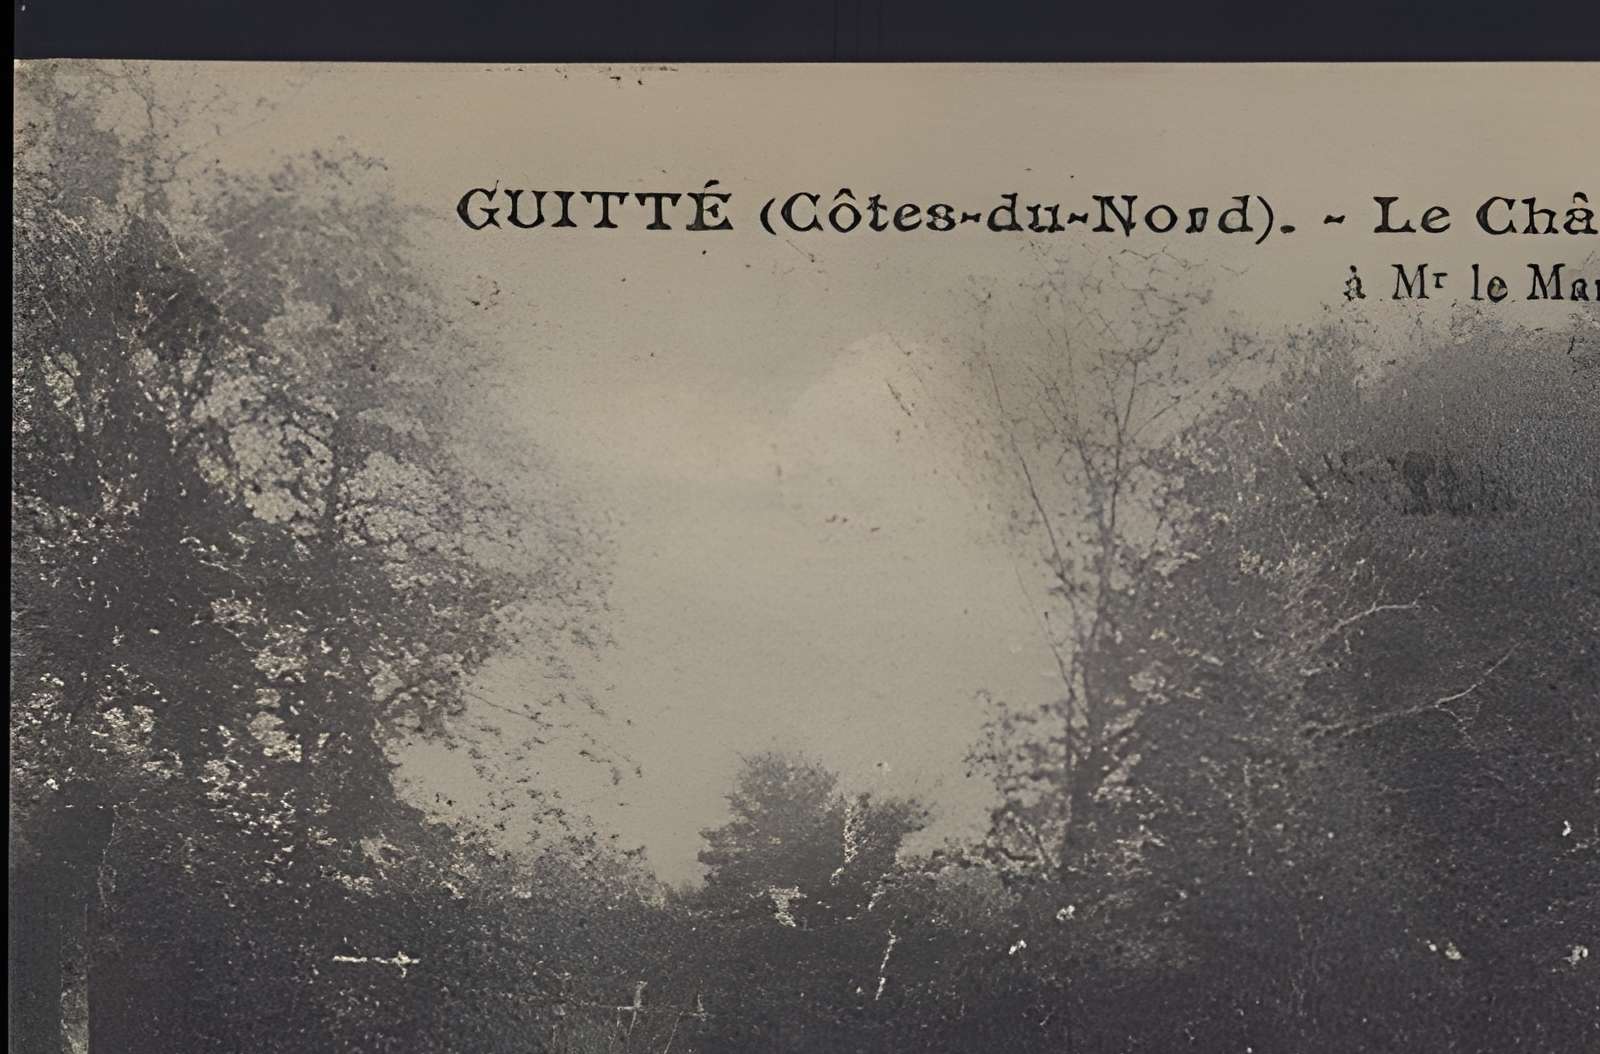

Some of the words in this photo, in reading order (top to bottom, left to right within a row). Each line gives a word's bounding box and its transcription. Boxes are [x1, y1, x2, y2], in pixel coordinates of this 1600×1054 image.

[456, 180, 735, 232] GUITTÉ
[1374, 196, 1451, 234] Le
[1343, 266, 1366, 302] à
[1472, 263, 1509, 303] le
